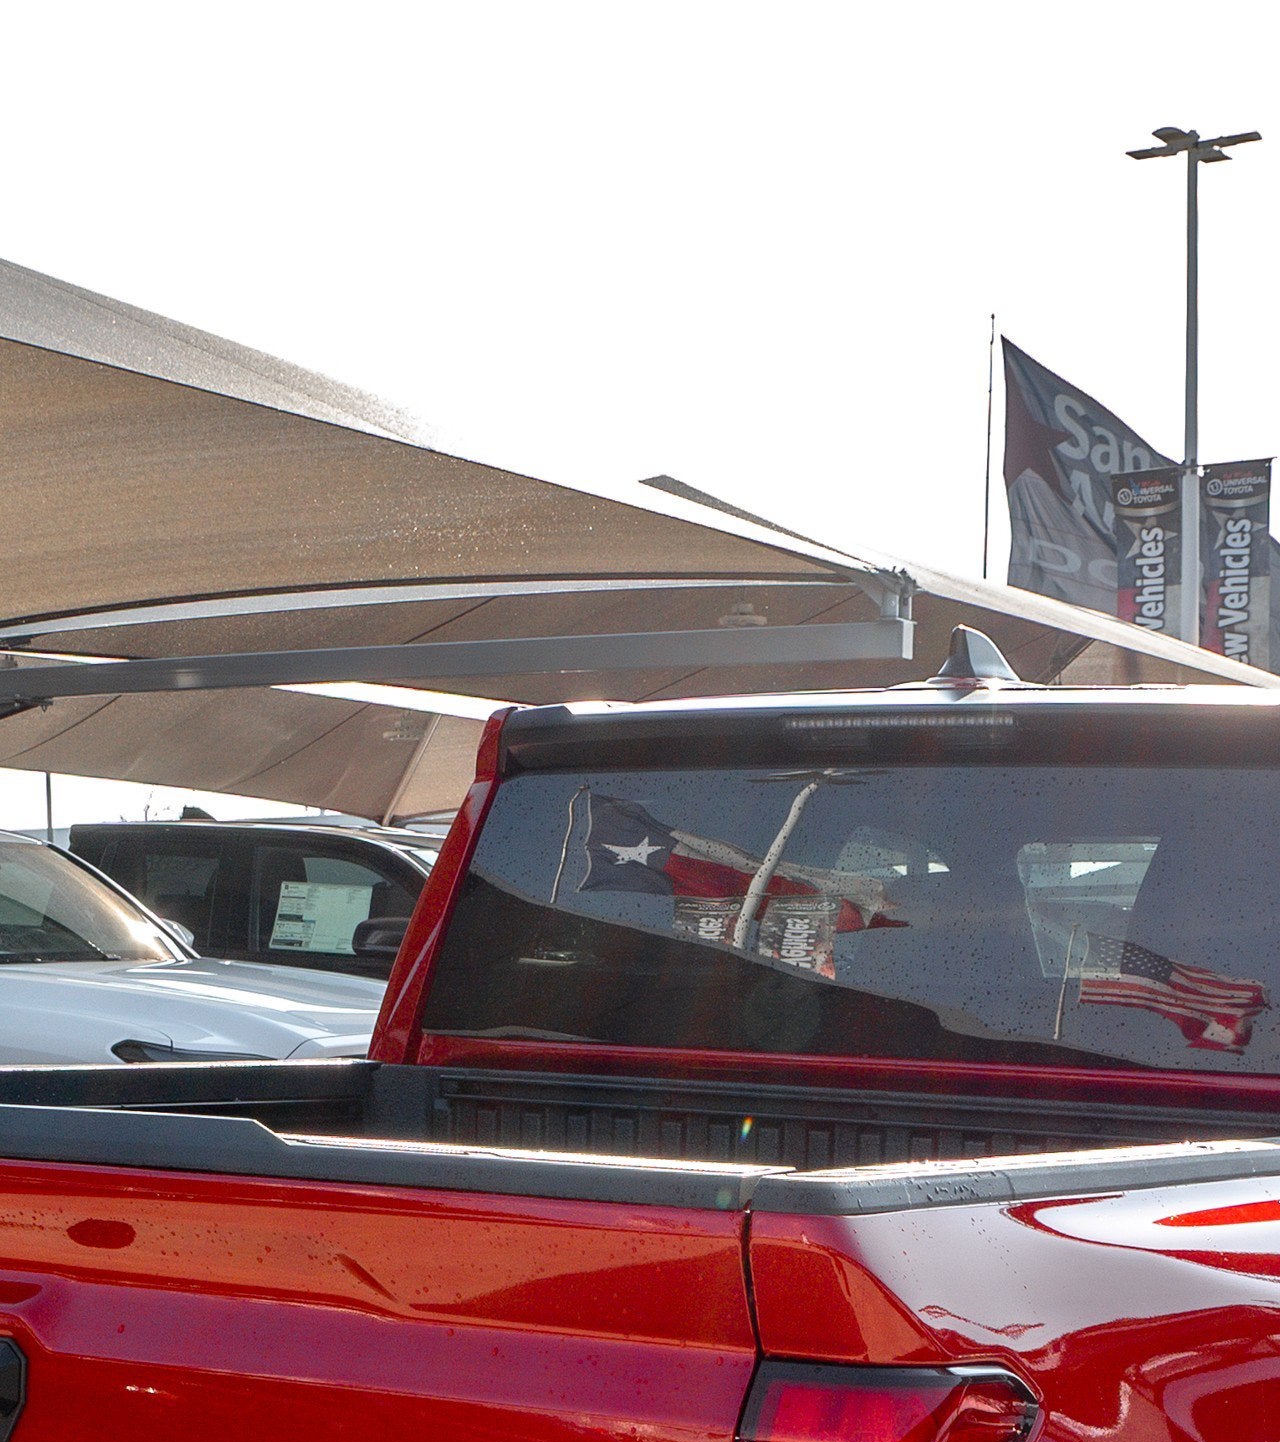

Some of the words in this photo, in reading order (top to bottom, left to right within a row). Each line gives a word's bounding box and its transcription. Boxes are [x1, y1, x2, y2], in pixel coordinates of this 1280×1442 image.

[1054, 393, 1151, 474] San
[1133, 494, 1162, 504] TOYOTA
[1222, 485, 1254, 496] TOYOTA
[1218, 518, 1252, 628] Vehicles
